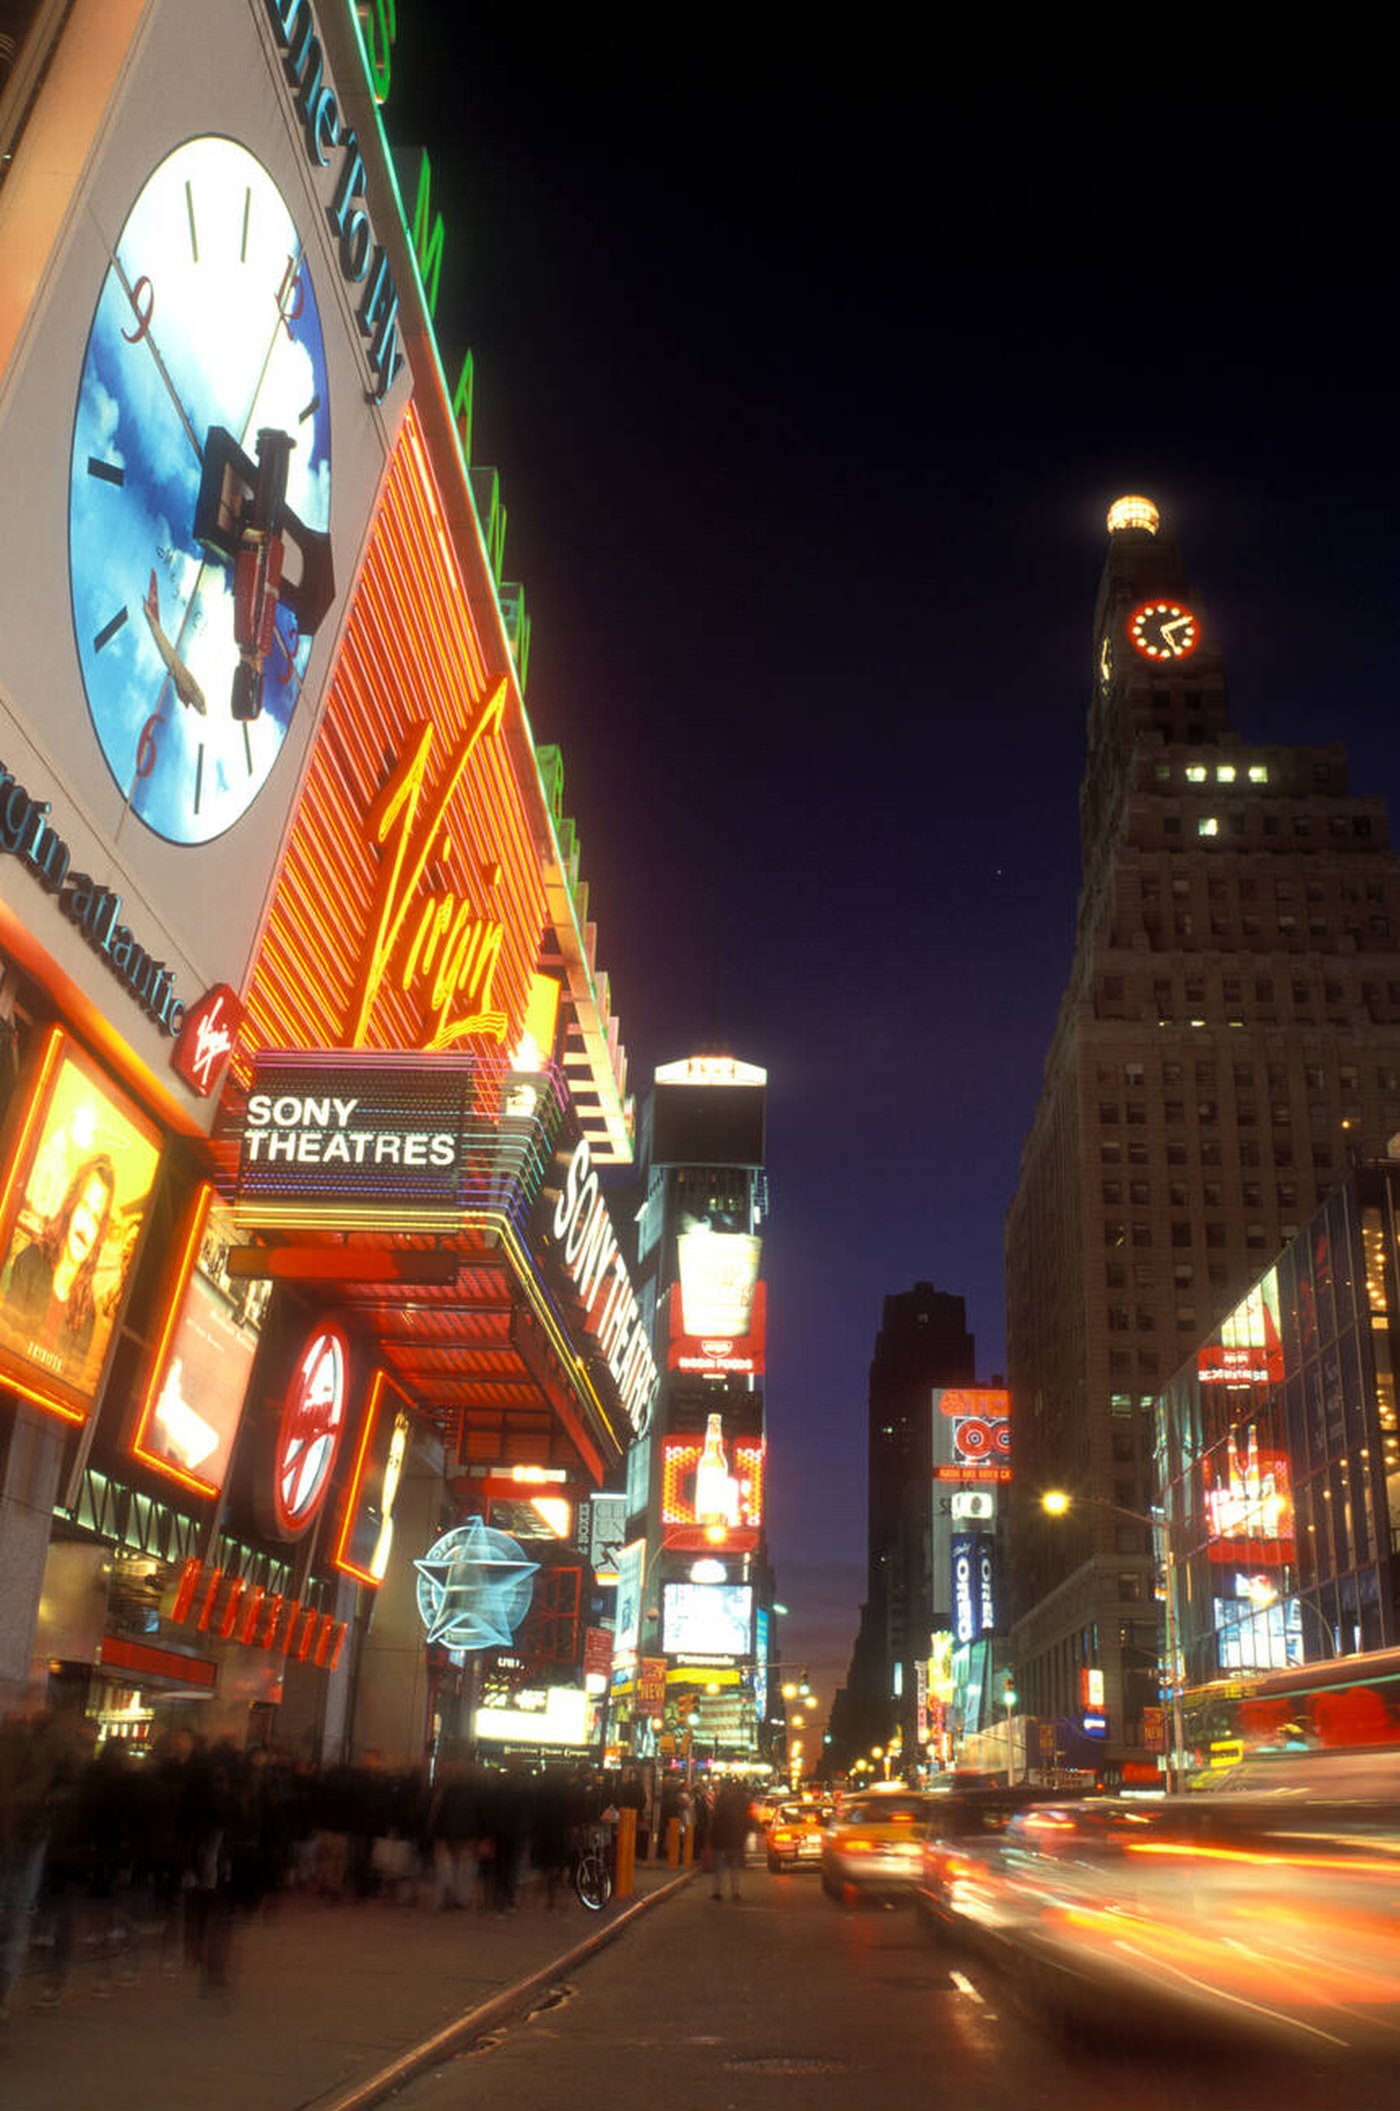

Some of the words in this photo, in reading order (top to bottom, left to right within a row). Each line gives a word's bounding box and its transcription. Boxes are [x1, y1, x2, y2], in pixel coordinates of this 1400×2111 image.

[120, 275, 154, 344] 9
[136, 714, 166, 778] 6
[353, 677, 509, 1052] Virgin
[62, 888, 185, 1038] atlantic
[193, 997, 232, 1086] Virgin
[244, 1131, 456, 1166] THEATRES
[247, 1095, 358, 1127] SONY
[554, 1138, 619, 1314] SONY
[957, 1557, 973, 1642] OREO
[639, 1681, 666, 1699] NEW
